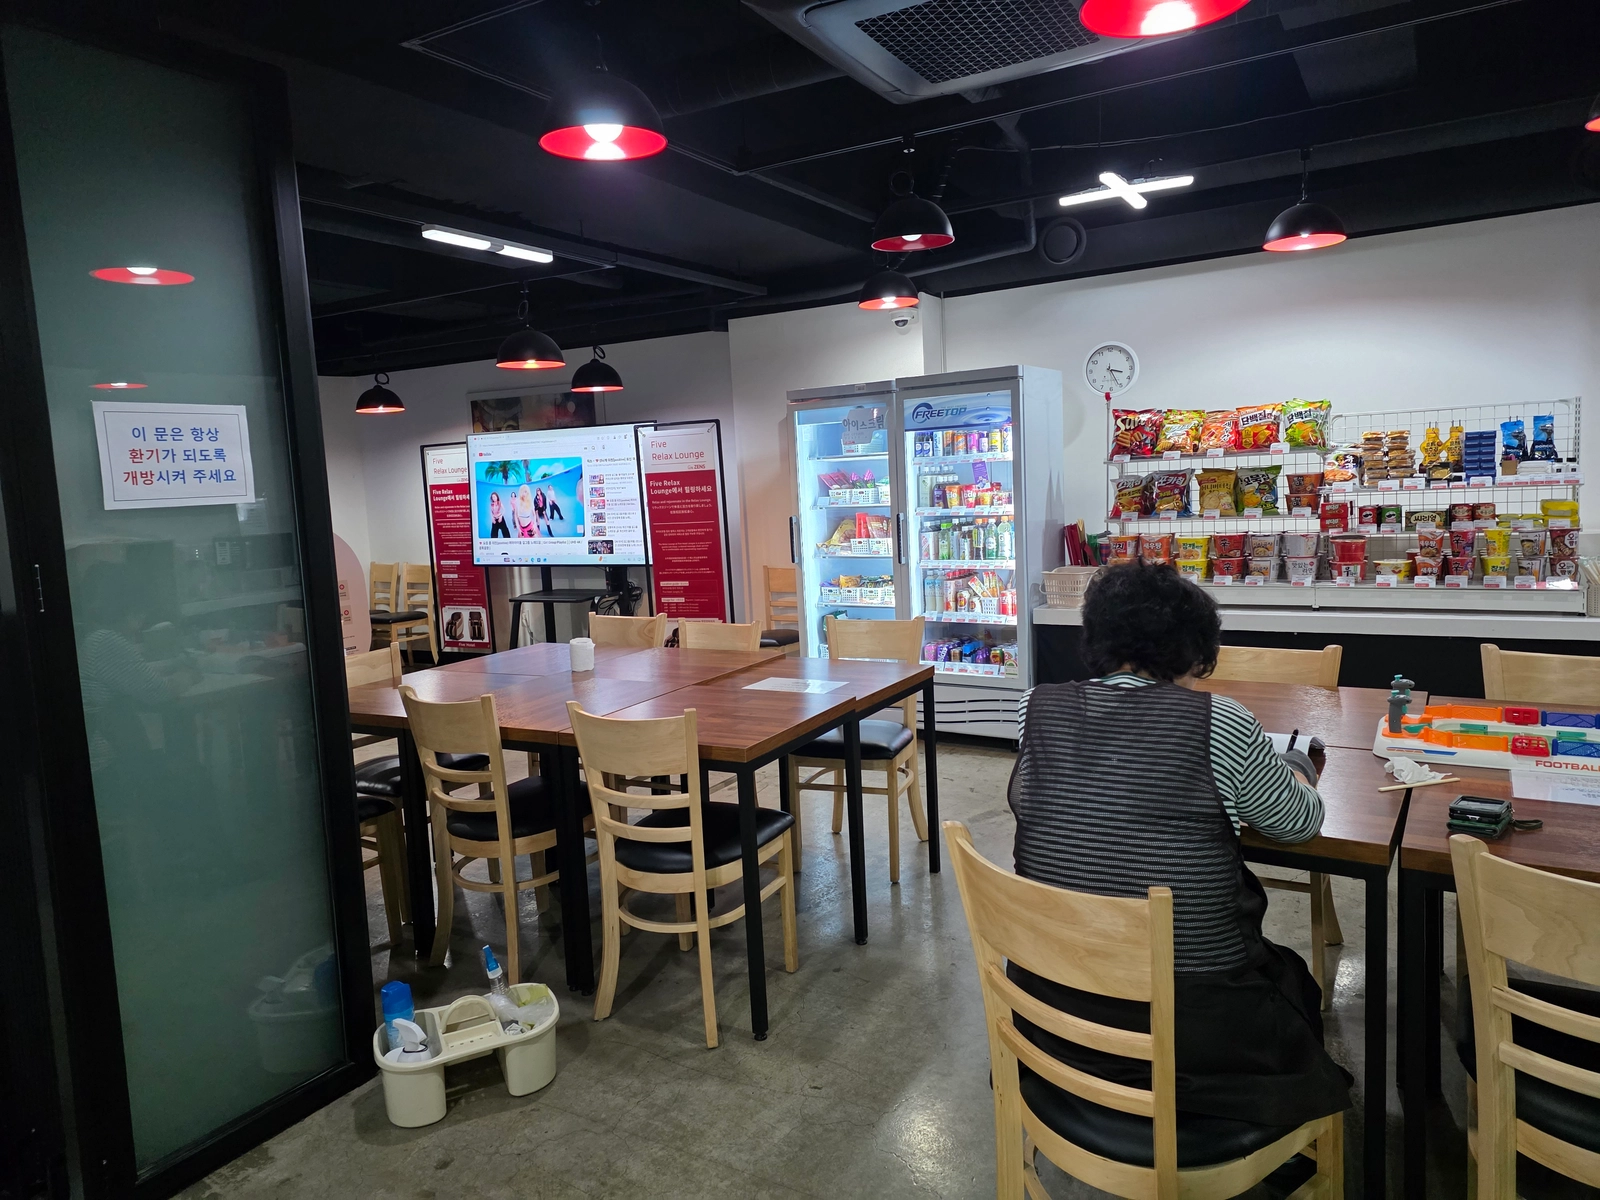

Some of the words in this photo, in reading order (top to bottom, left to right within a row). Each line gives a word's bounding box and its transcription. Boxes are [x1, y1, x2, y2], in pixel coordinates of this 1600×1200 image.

[915, 407, 967, 420] FREETOP
[842, 414, 884, 431] 아이스크림
[132, 426, 146, 442] 이
[154, 427, 184, 442] 문은
[190, 427, 220, 443] 항상
[651, 440, 667, 448] Five
[128, 448, 177, 464] 환기가
[182, 448, 227, 463] 되도록
[651, 452, 673, 461] Relax
[674, 450, 705, 460] Lounge
[123, 470, 186, 486] 개방시켜
[192, 469, 237, 484] 주세요
[1157, 474, 1185, 487] 포카칩
[650, 486, 683, 495] Lounge에서
[684, 485, 712, 494] 힐링하세요
[1220, 538, 1231, 552] 辛
[1452, 534, 1465, 550] 辛
[1535, 760, 1600, 772] FOOTBAL
